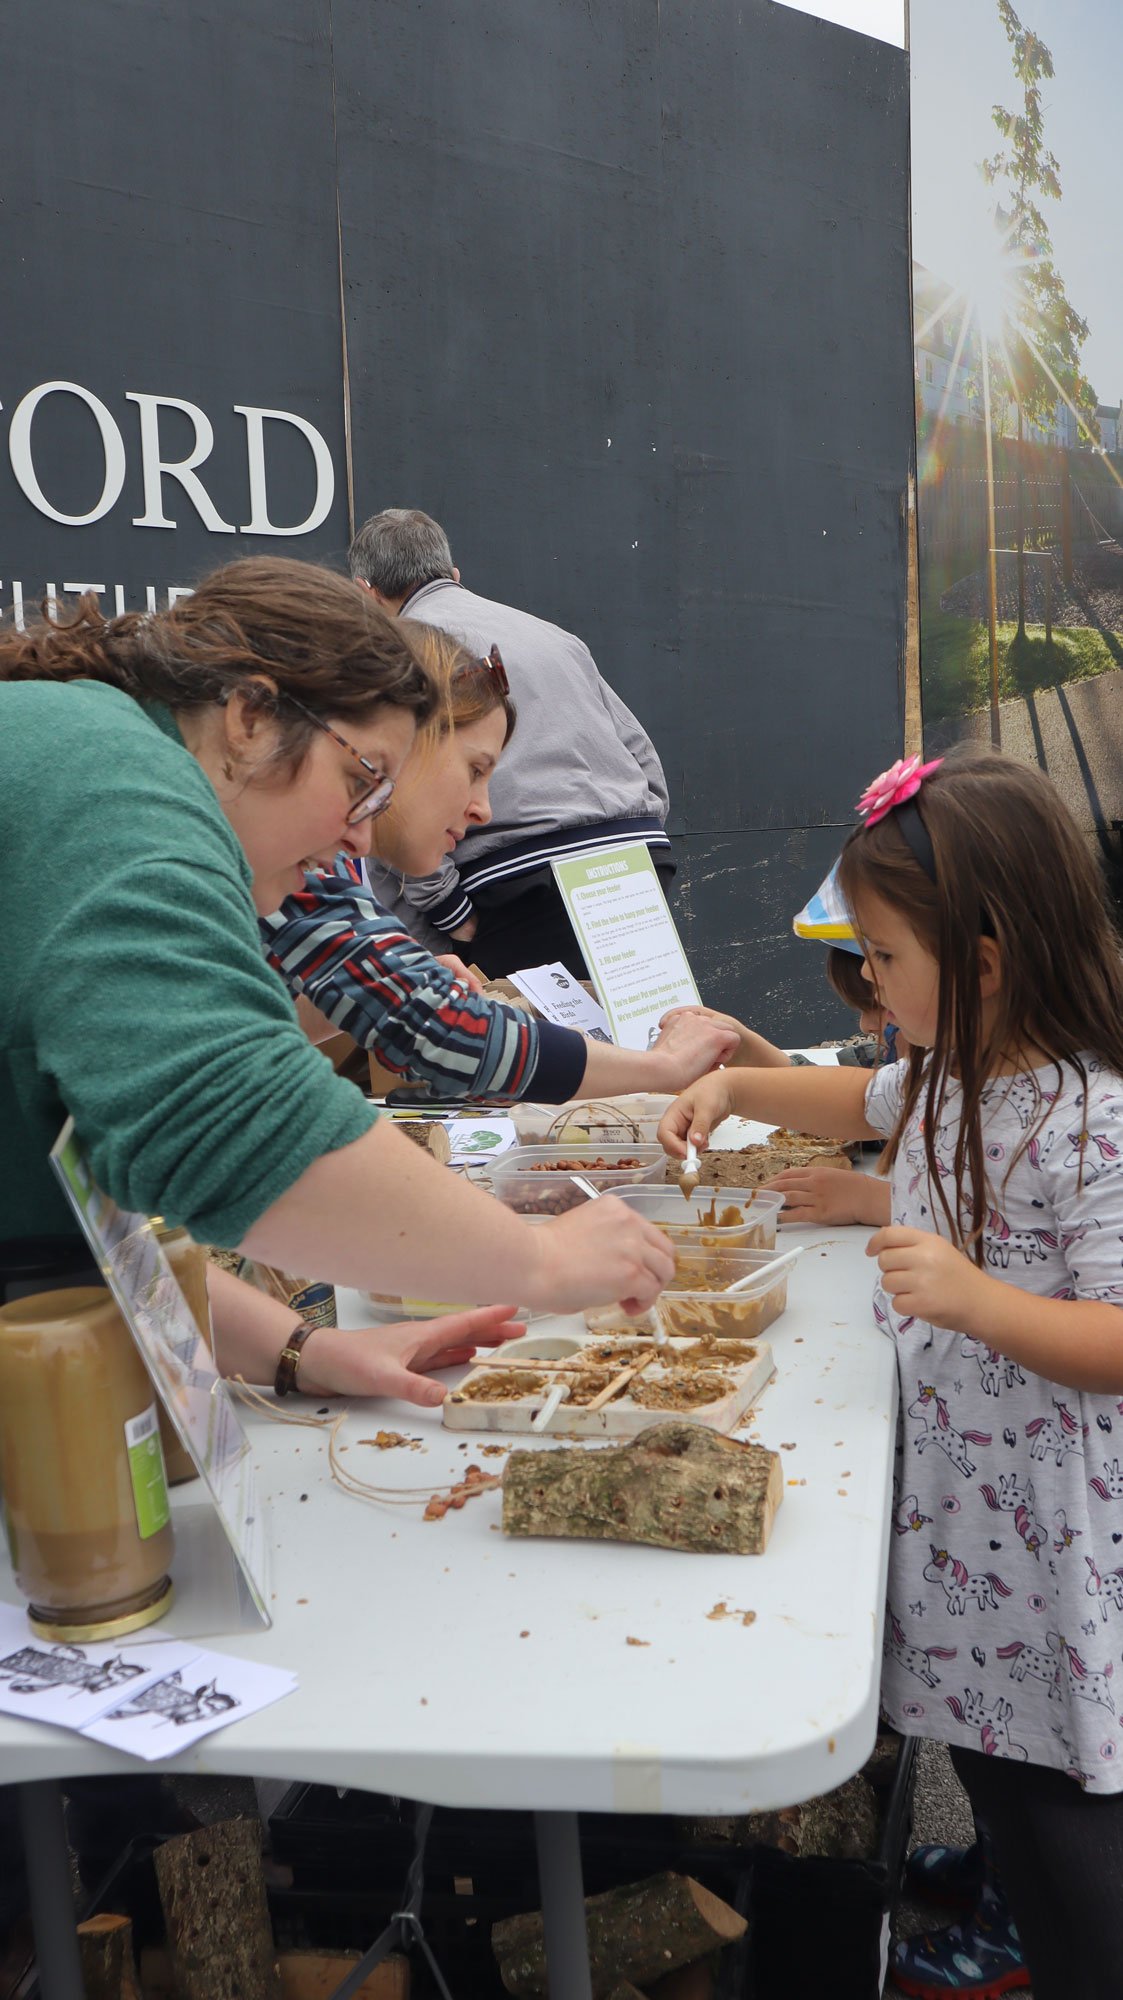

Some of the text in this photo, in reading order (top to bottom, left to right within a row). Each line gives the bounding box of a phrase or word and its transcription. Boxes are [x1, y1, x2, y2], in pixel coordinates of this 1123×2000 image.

[0, 380, 335, 536] ORD
[586, 860, 629, 879] INSTRUCTIONS
[580, 890, 597, 899] Choose
[591, 920, 602, 928] Find
[624, 911, 636, 920] hang
[636, 909, 646, 917] your
[645, 904, 660, 913] feeder
[611, 954, 622, 962] your
[649, 989, 659, 997] your
[551, 999, 576, 1009] Feeding
